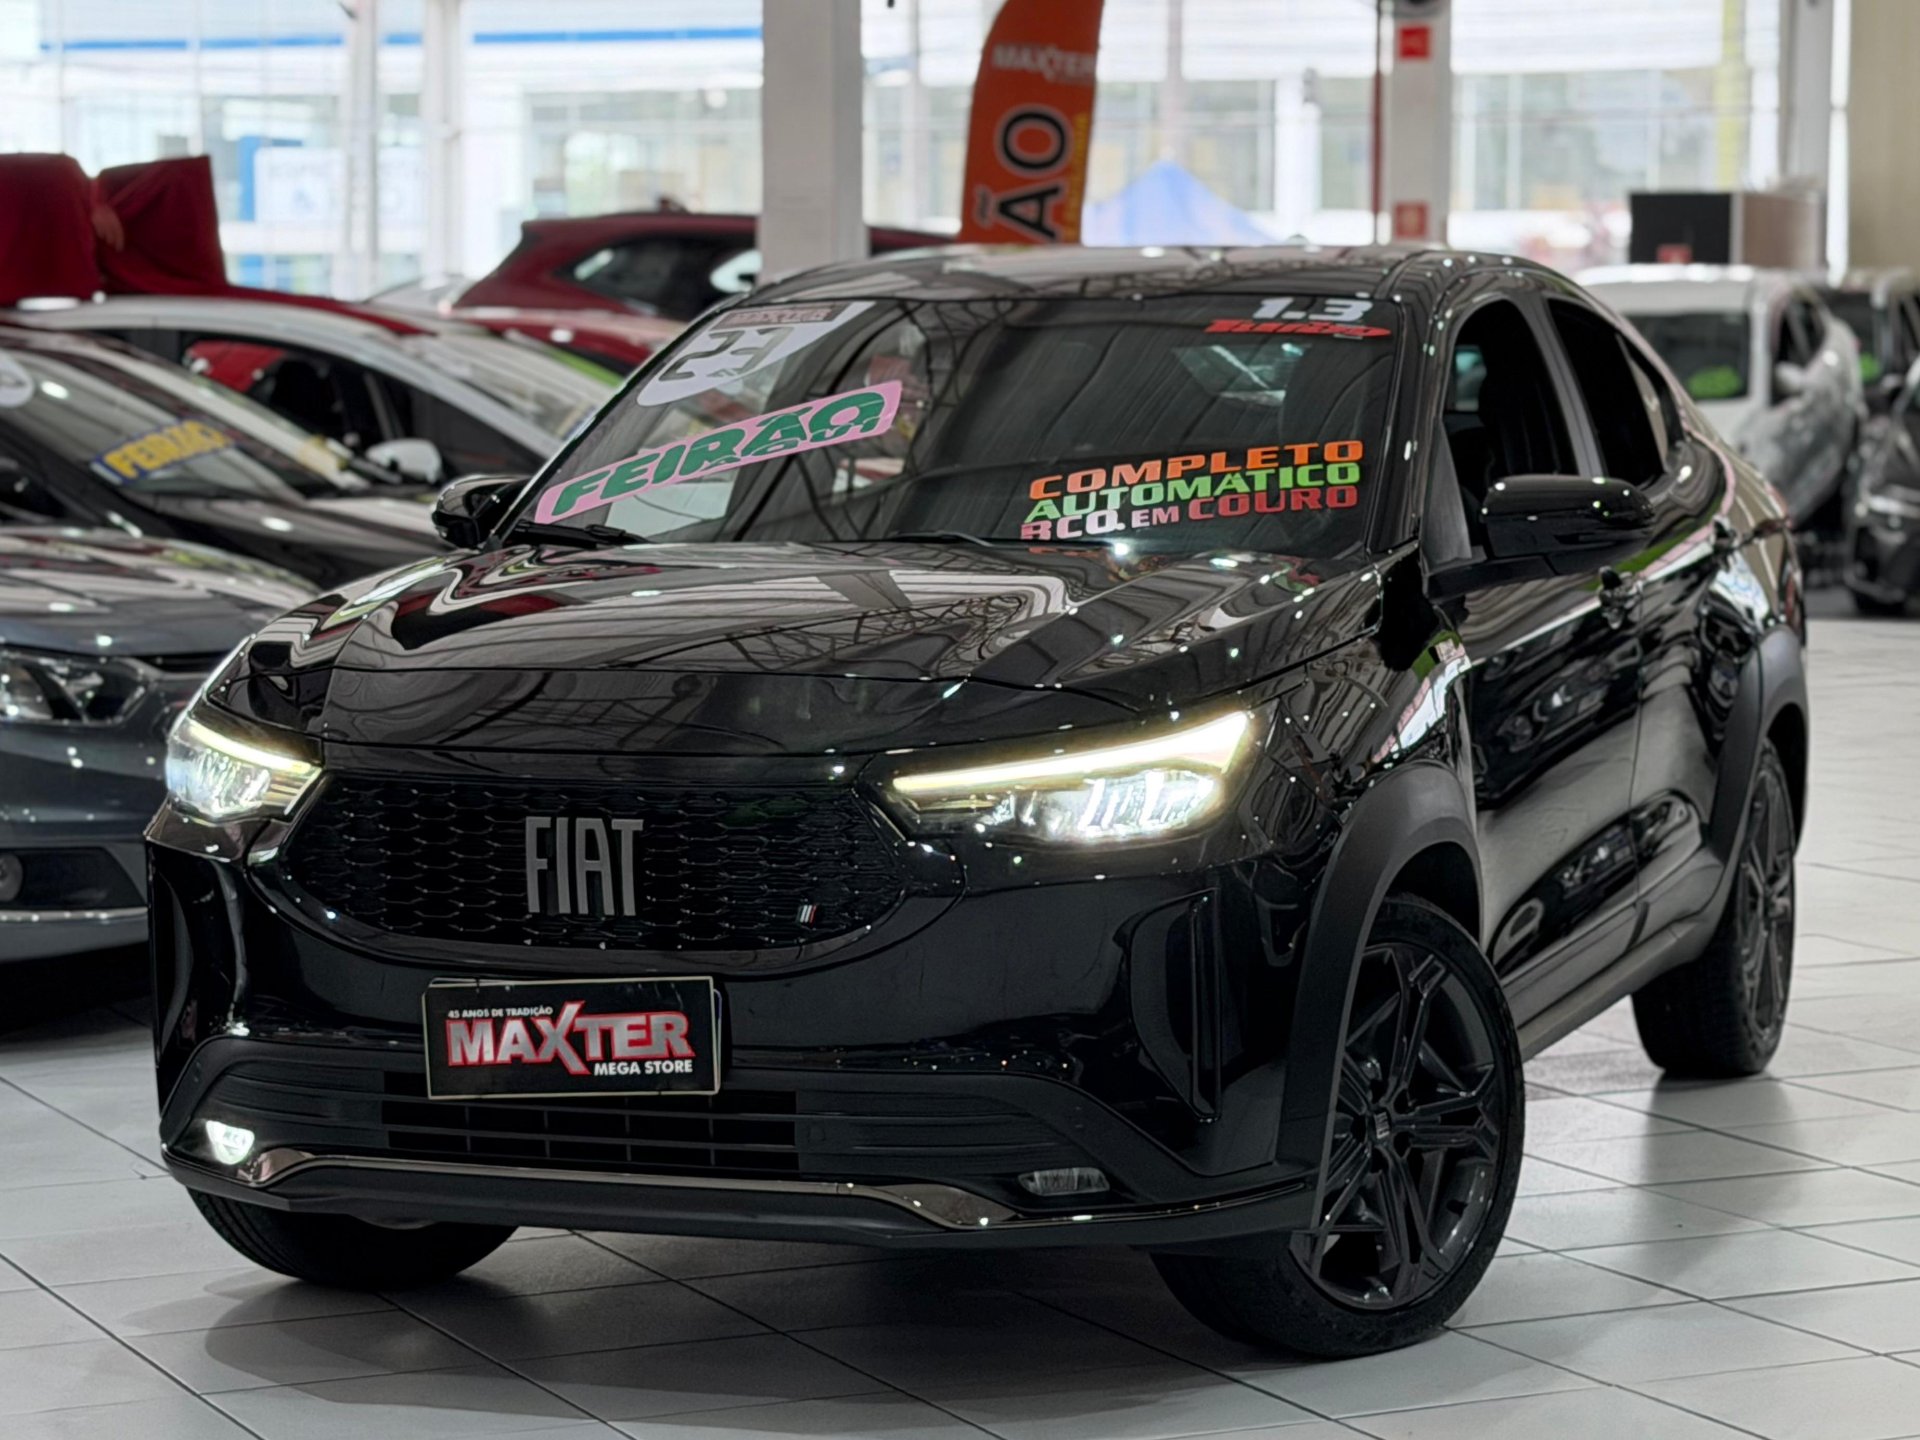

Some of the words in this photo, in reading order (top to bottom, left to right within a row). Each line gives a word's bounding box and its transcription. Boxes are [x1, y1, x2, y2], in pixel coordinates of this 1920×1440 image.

[991, 43, 1095, 82] MAXTER
[1252, 297, 1373, 321] 1.3
[551, 392, 885, 516] FEIRÃO
[1029, 440, 1364, 499] COMPLETO
[1131, 505, 1180, 529] EM
[1188, 485, 1359, 521] COURO
[525, 815, 644, 916] FIAT
[447, 1009, 460, 1019] 45
[462, 1008, 490, 1018] ANOS
[491, 1007, 504, 1017] DE
[506, 1004, 553, 1017] TRADIÇÃO
[446, 1000, 696, 1076] MAXTER
[594, 1061, 641, 1076] MEGA
[645, 1059, 693, 1074] STORE
